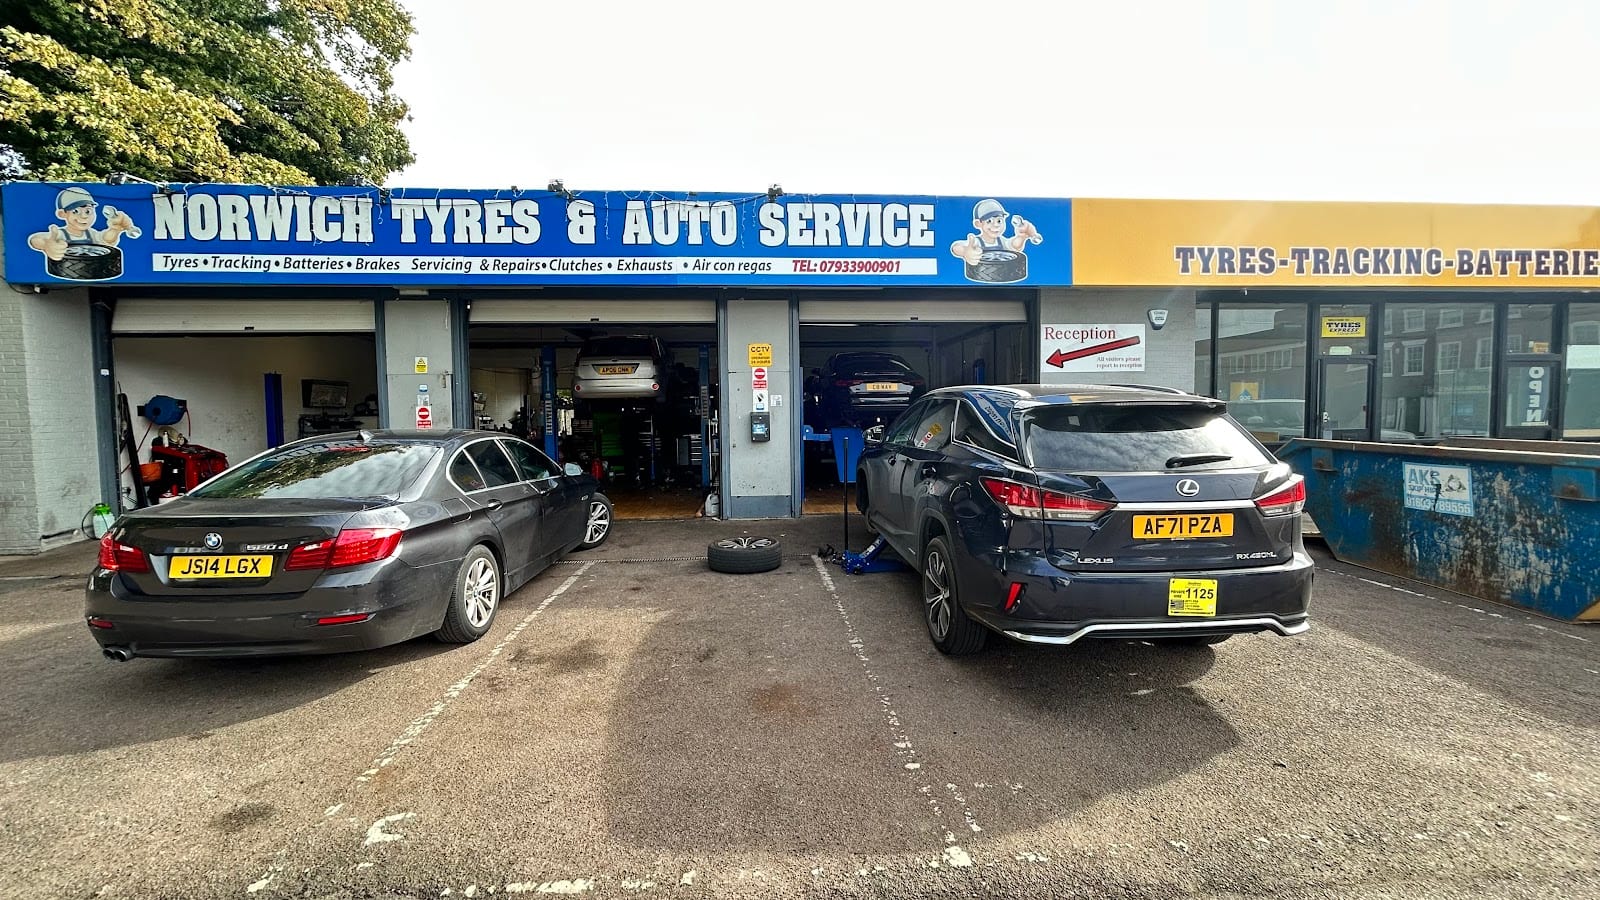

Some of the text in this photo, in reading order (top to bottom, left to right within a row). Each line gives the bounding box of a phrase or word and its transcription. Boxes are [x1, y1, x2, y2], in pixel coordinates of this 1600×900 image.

[152, 193, 936, 248] NORWICH TYRES & AUTO SERVICE
[162, 255, 901, 275] Tyres Tracking Batteries Brakes Servicing & Repairs Clutches Exhausts Air con regas TEL: 07933900901
[1044, 326, 1117, 343] Reception
[1143, 516, 1222, 535] AF71 PZA
[180, 557, 261, 575] JS14 LGX
[1185, 588, 1214, 600] 1125
